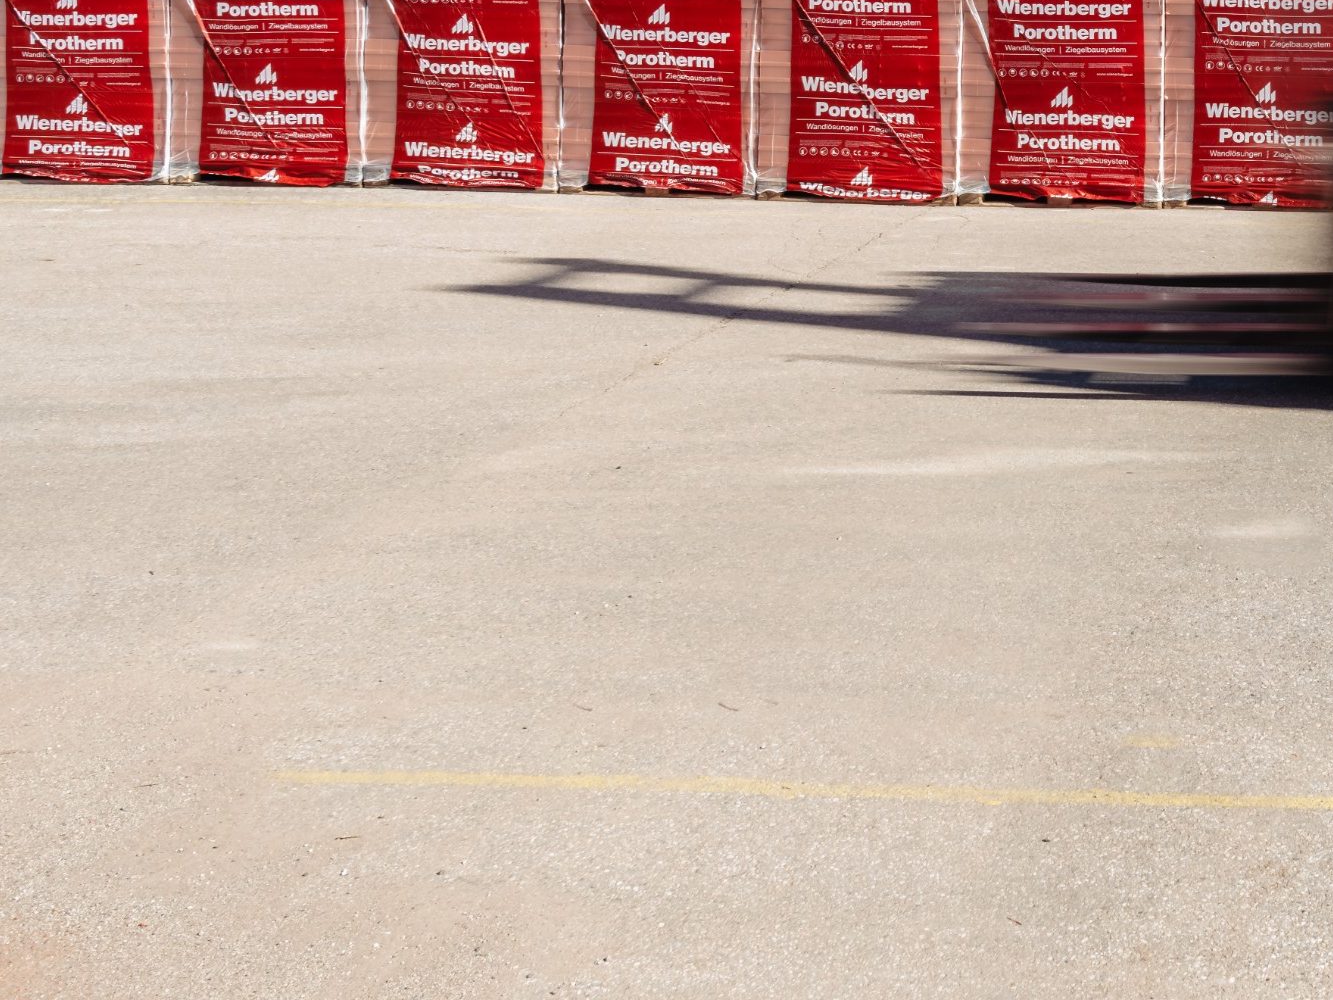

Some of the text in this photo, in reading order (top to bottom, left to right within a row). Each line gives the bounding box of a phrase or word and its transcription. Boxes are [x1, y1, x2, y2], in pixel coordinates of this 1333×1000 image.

[217, 2, 318, 16] Porotherm
[998, 0, 1131, 18] Wienerberger
[208, 22, 328, 32] Wandlösungen Ziegelbausystem
[861, 18, 921, 28] Ziegelbausystem
[1217, 18, 1321, 34] Porotherm
[601, 24, 730, 46] Wienerberger
[1014, 24, 1117, 39] Porotherm
[405, 34, 529, 56] Wienerberger
[1065, 46, 1127, 55] Ziegelbausystem
[1270, 39, 1331, 48] Ziegelbausystem
[417, 59, 515, 78] Porotherm
[16, 115, 143, 137] Wienerberger
[1006, 109, 1134, 129] Wienerberger
[805, 124, 858, 132] Wandlösungen
[29, 142, 130, 157] Porotherm
[405, 142, 534, 165] Wienerberger
[1210, 149, 1262, 158] Wandlösungen
[615, 158, 718, 176] Porotherm
[801, 183, 928, 199] Wienerberger
